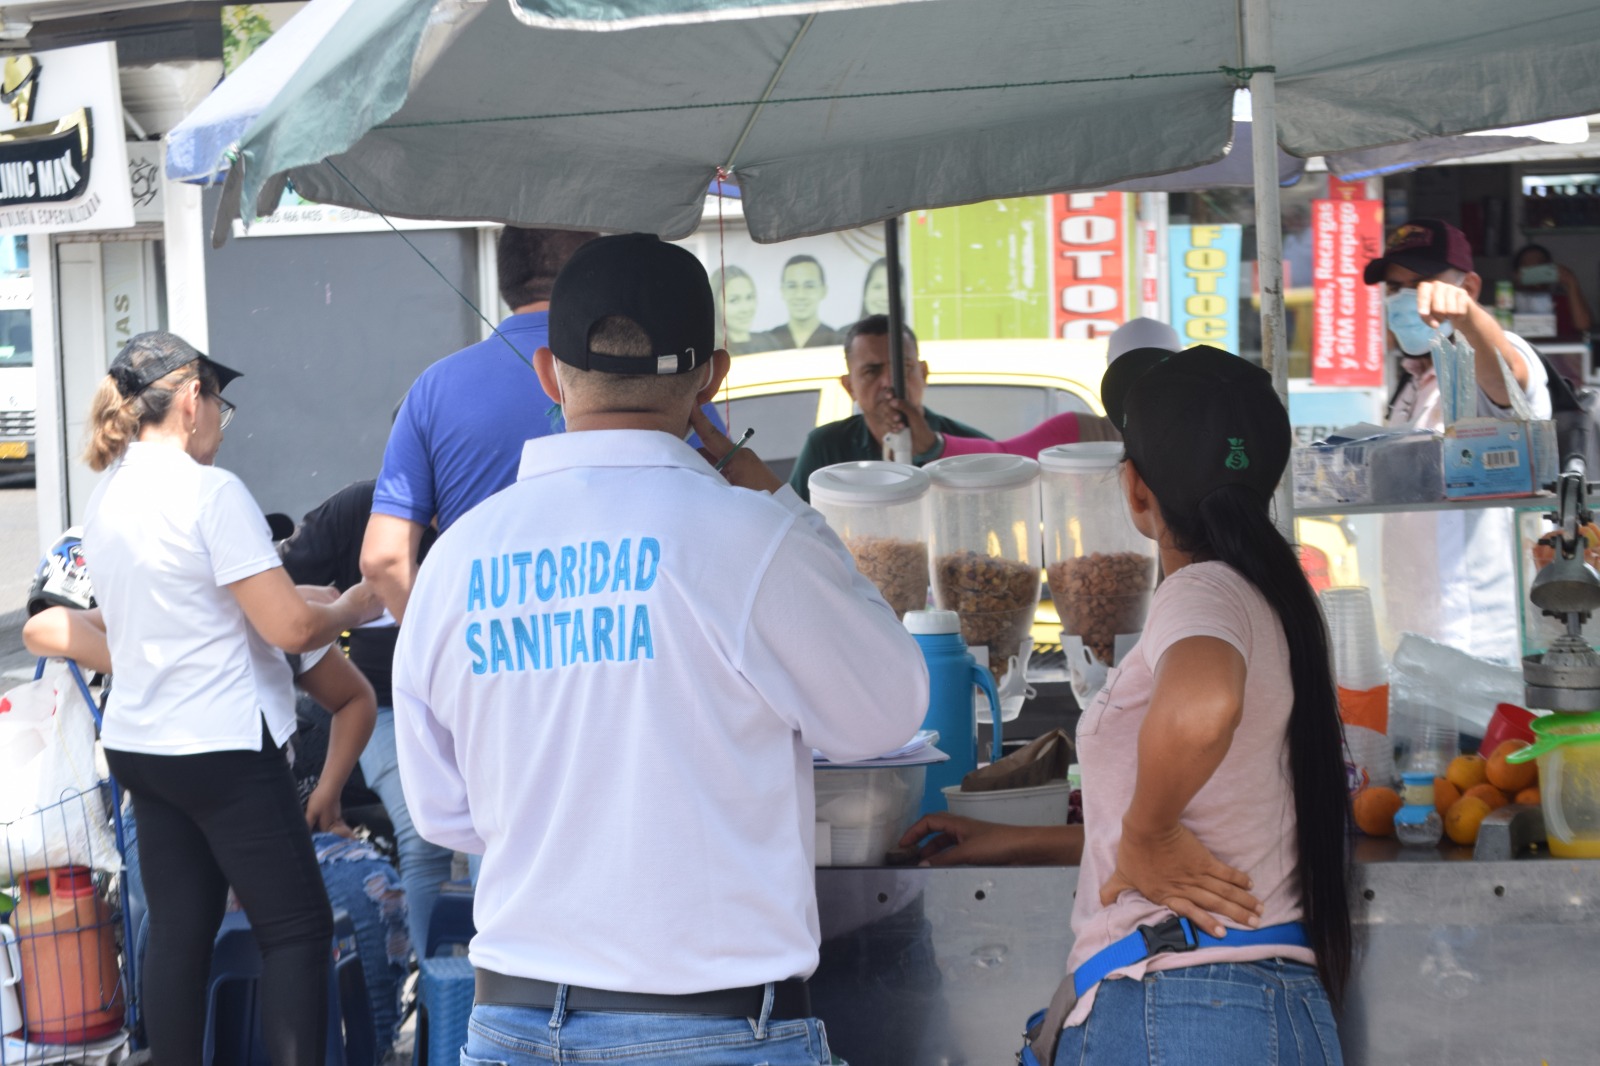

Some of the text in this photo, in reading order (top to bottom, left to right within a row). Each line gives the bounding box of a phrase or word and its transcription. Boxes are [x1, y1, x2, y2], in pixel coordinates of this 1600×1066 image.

[37, 149, 81, 197] MAK
[1314, 201, 1338, 369] Paquetes, Recargas
[1336, 202, 1359, 370] y SIM card prepago
[1364, 319, 1383, 371] Compra
[467, 537, 661, 612] AUTORIDAD
[466, 604, 654, 675] SANITARIA
